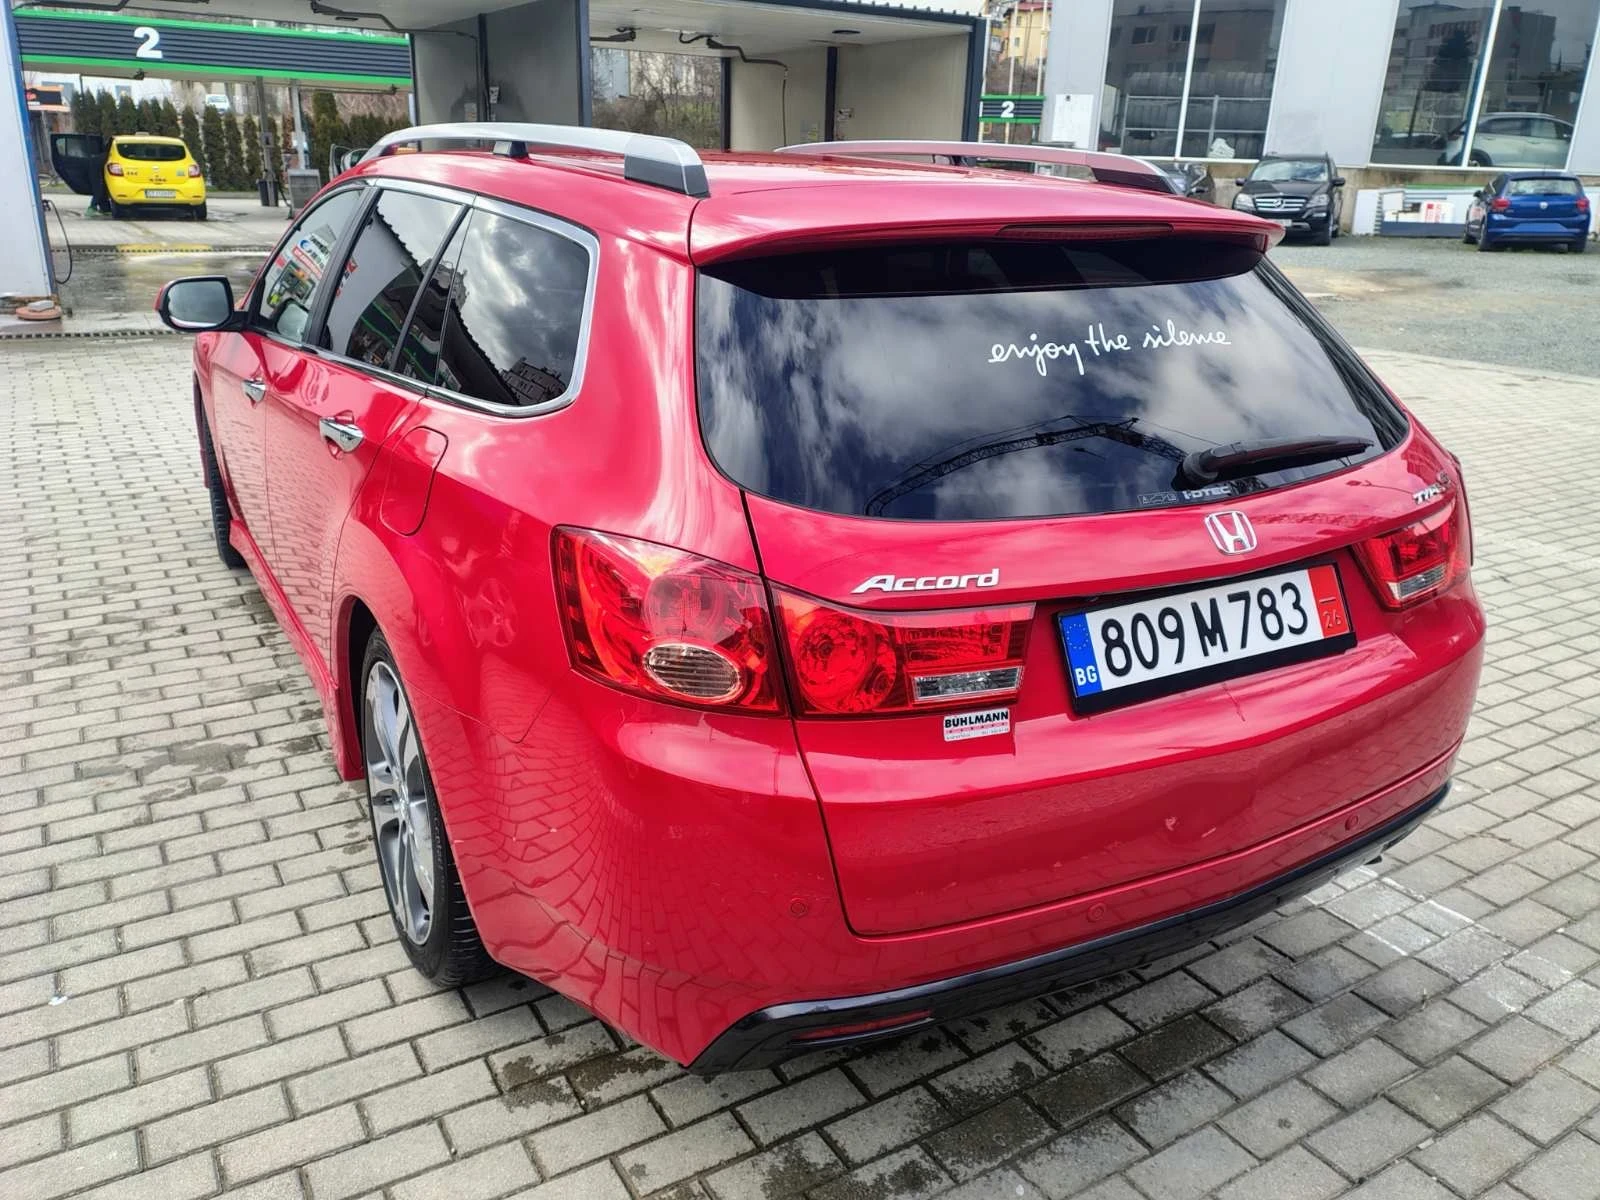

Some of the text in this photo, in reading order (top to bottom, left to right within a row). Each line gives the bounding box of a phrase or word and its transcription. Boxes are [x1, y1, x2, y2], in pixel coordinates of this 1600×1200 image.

[134, 26, 162, 58] 2
[1001, 101, 1015, 118] 2
[988, 319, 1231, 376] enjoy the silence
[851, 568, 1000, 594] Accord
[1074, 665, 1098, 687] BG
